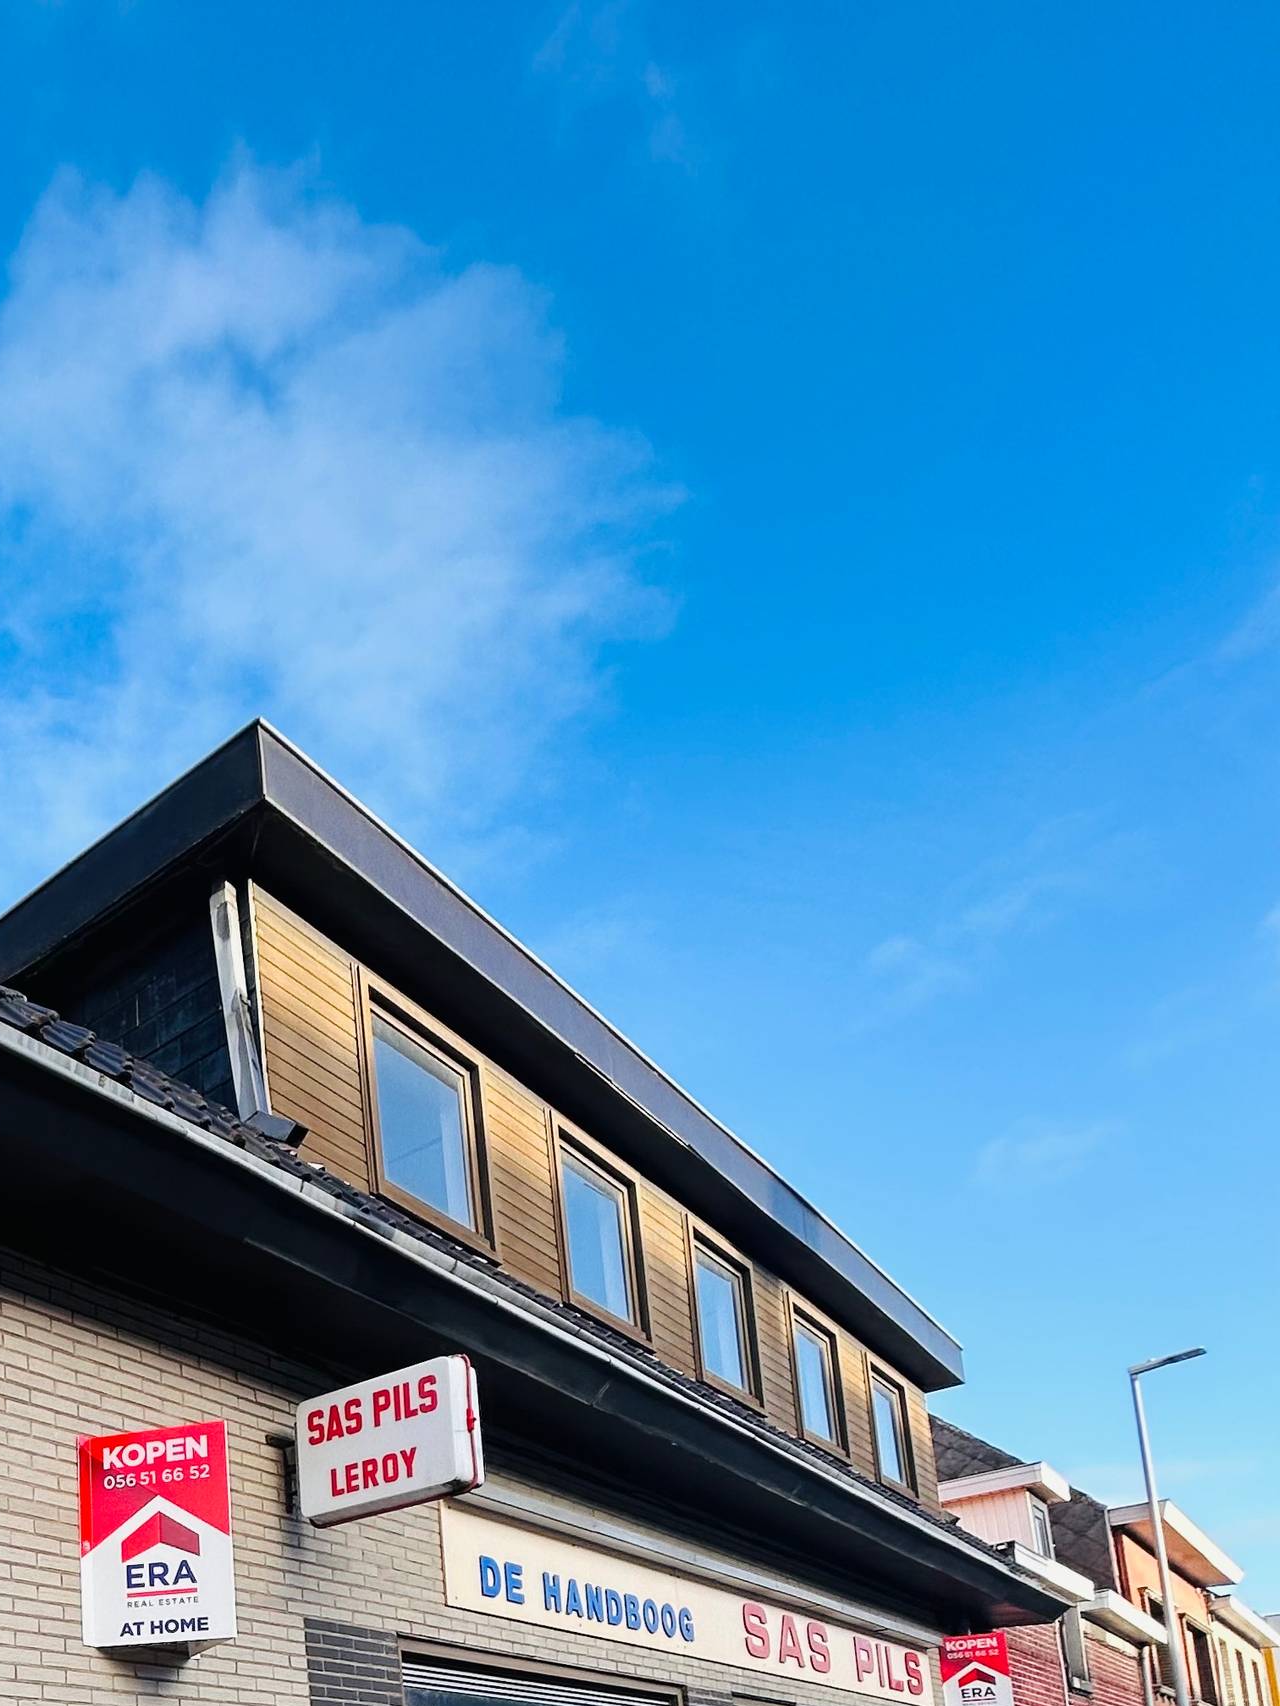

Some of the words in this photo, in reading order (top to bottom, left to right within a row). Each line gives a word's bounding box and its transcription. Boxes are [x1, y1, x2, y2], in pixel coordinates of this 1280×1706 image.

[307, 1398, 363, 1446] SAS
[372, 1374, 438, 1428] PILS
[102, 1434, 209, 1470] KOPEN
[103, 1472, 137, 1490] 056
[139, 1470, 157, 1486] 51
[161, 1467, 184, 1483] 66
[189, 1463, 210, 1480] 52
[330, 1447, 417, 1498] LEROY
[126, 1559, 198, 1589] ERA
[126, 1599, 154, 1608] REAL
[158, 1596, 199, 1606] ESTATE
[478, 1554, 525, 1605] DE
[542, 1571, 695, 1642] HANDBOOG
[119, 1621, 145, 1638] AT
[150, 1616, 210, 1635] HOME
[742, 1602, 831, 1674] SAS
[852, 1635, 924, 1696] PILS
[945, 1637, 998, 1652] KOPEN
[961, 1686, 996, 1699] ERA
